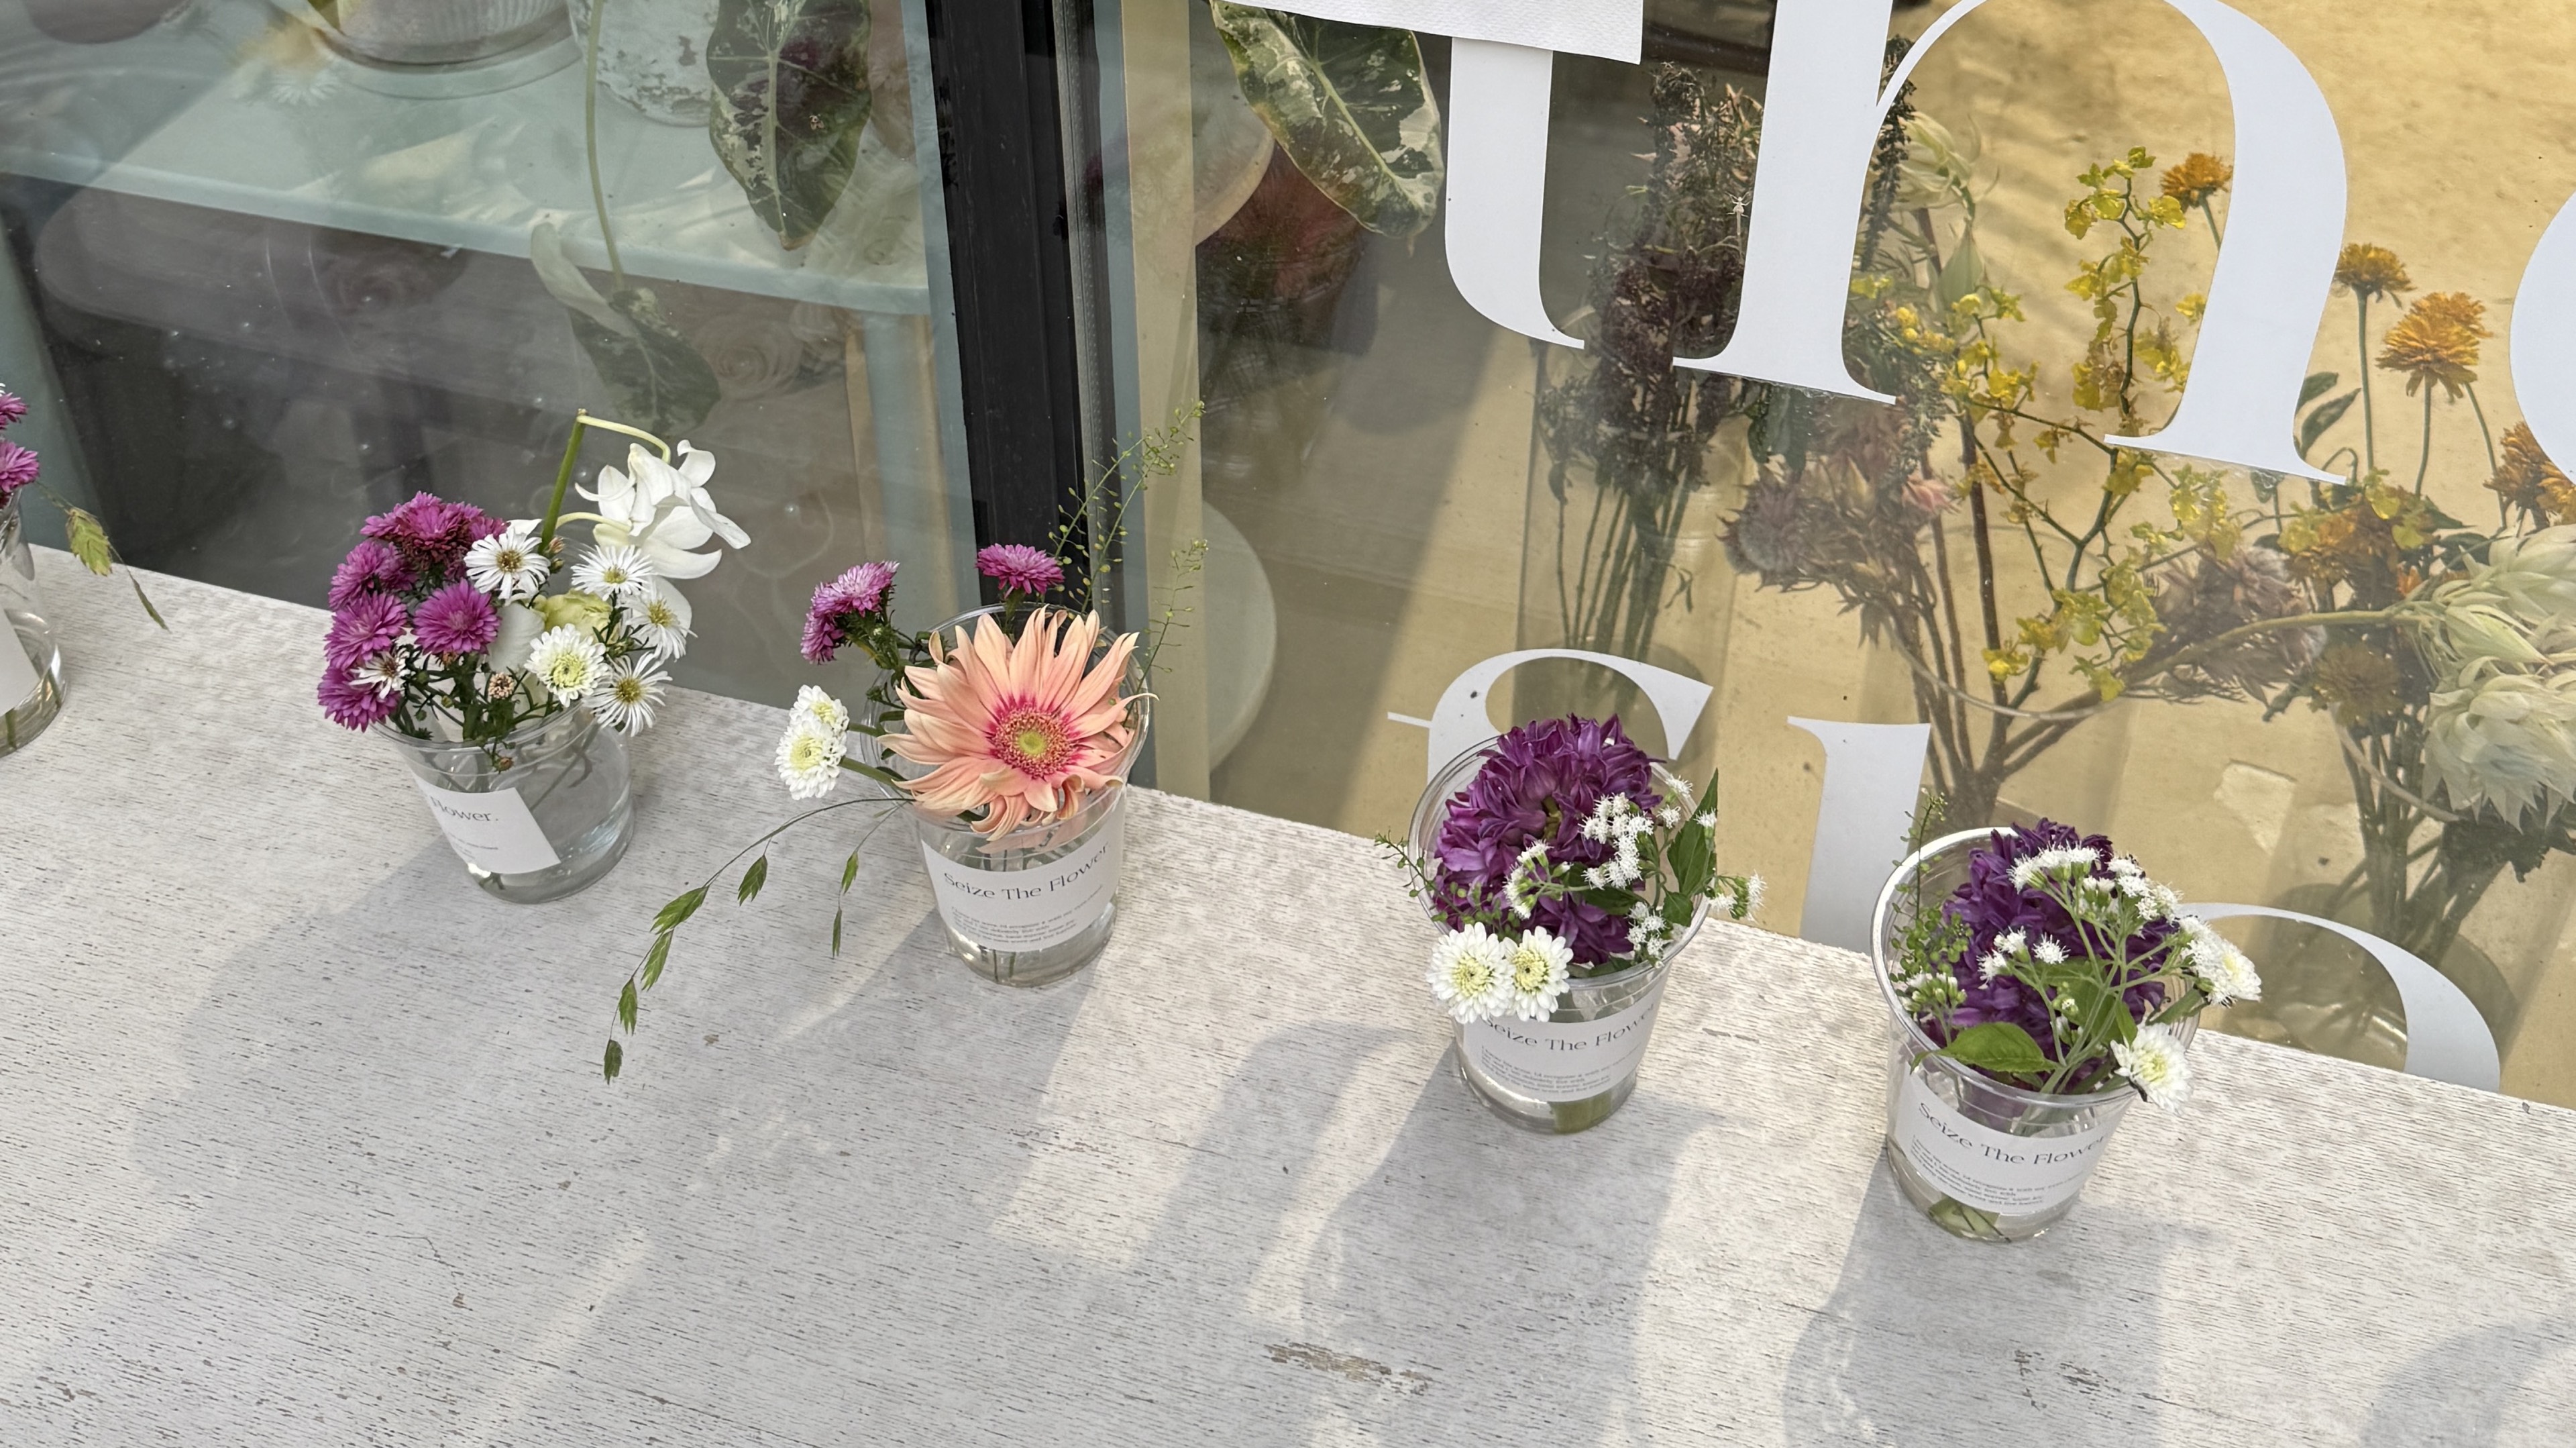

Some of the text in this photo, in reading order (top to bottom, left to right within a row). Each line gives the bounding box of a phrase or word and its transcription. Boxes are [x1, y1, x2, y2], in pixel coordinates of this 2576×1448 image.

[1445, 0, 2576, 483] th
[943, 872, 996, 900] Seize
[1001, 886, 1042, 900] The
[1544, 1037, 1588, 1051] The
[1919, 1102, 1973, 1149] Seize
[1980, 1143, 2025, 1164] The
